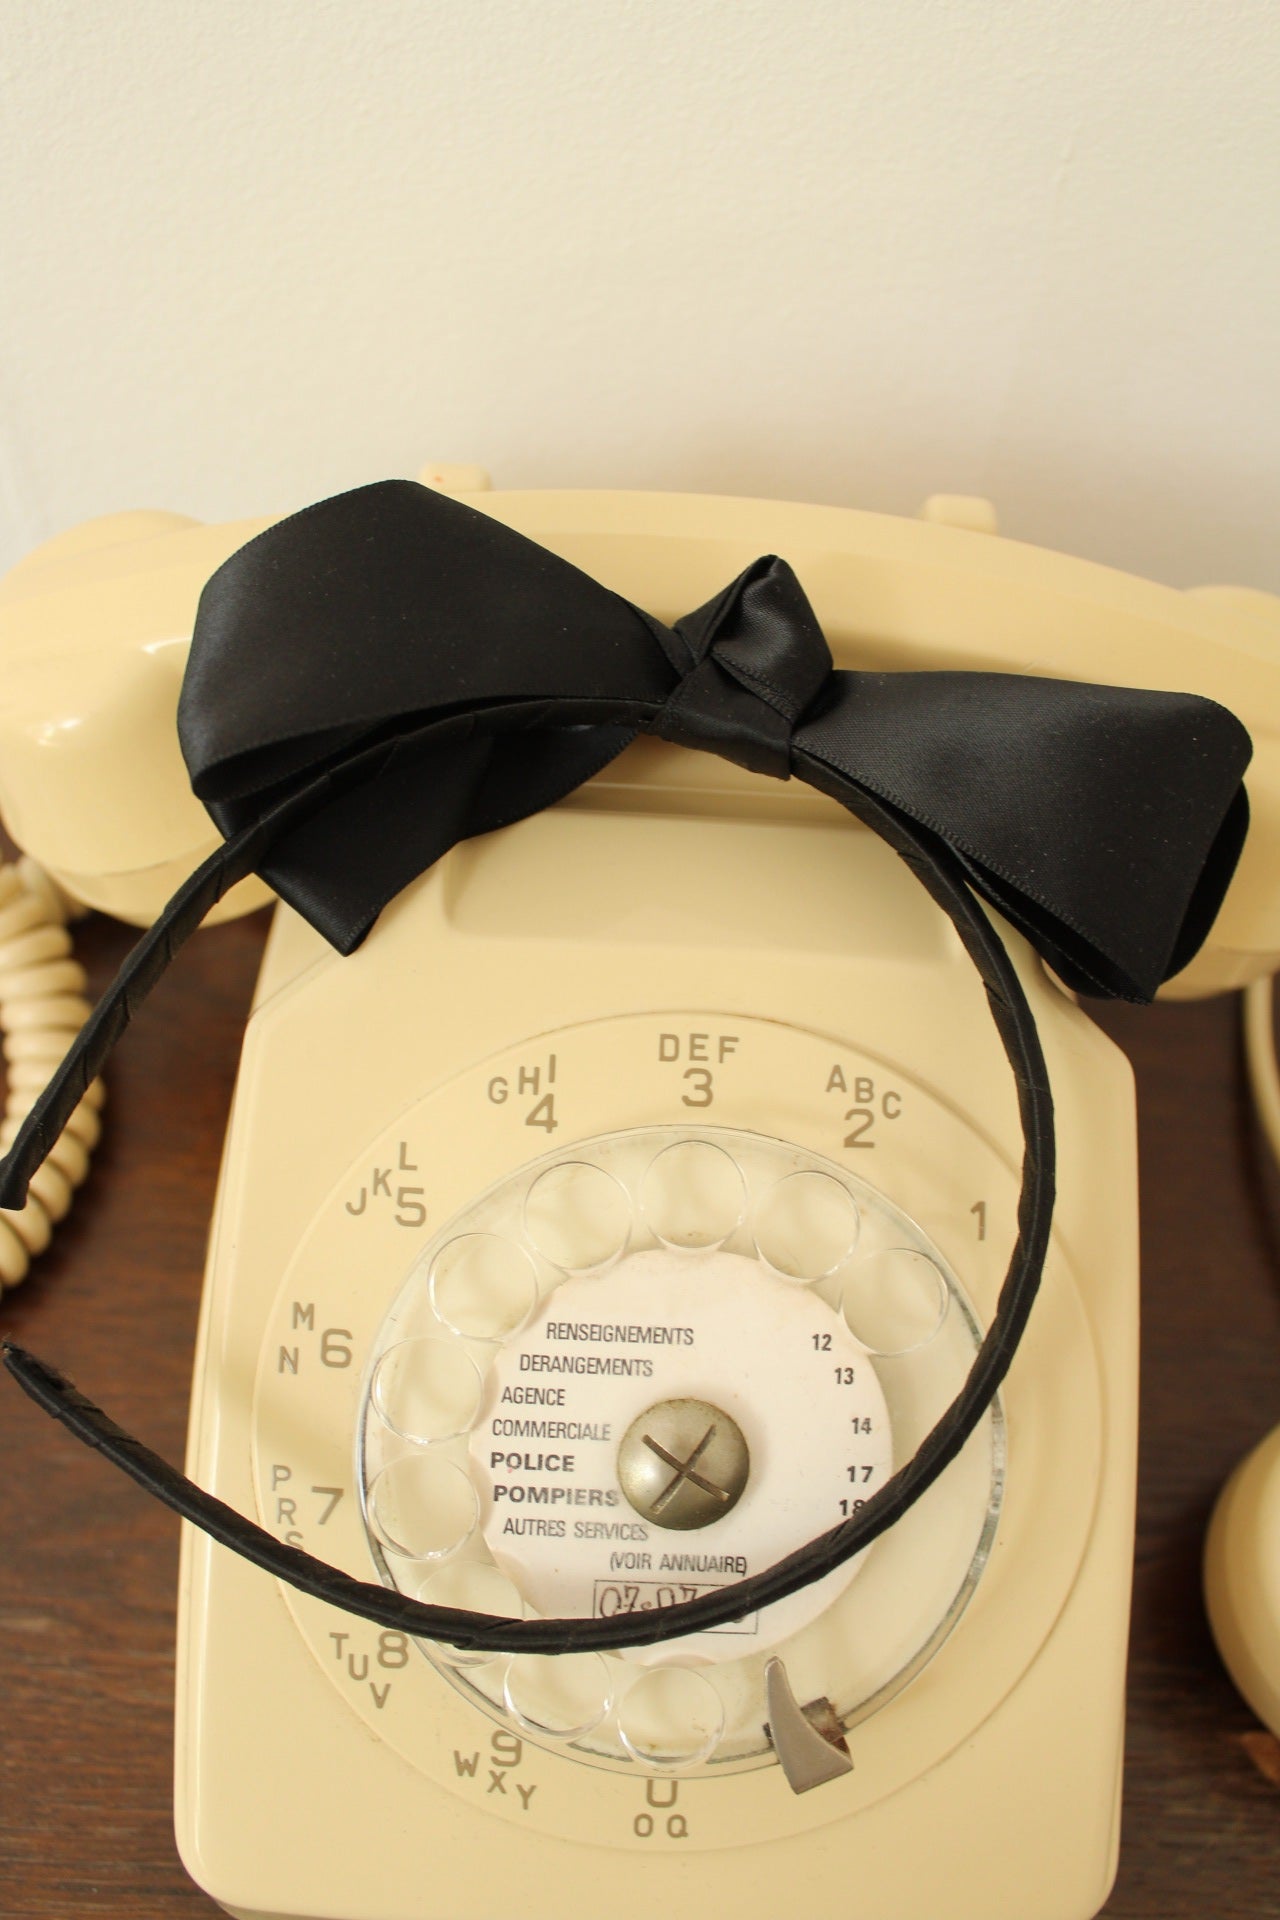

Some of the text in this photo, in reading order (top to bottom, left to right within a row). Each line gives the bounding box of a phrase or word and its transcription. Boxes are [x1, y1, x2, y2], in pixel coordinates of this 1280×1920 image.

[658, 1033, 740, 1064] DEF
[487, 1054, 557, 1105] GHI
[681, 1067, 714, 1108] 3
[825, 1064, 902, 1120] ABC
[524, 1093, 558, 1134] 4
[843, 1108, 875, 1149] 2
[345, 1141, 418, 1216] JKL
[394, 1186, 427, 1228] 5
[970, 1201, 986, 1241] 1
[320, 1328, 353, 1369] 6
[546, 1321, 833, 1351] RENSEIGNEMENTS 12
[519, 1353, 854, 1385] DERANGEMENTS 13
[500, 1386, 566, 1407] AGENCE
[492, 1417, 872, 1442] COMMERCIALE 14
[490, 1451, 874, 1483] POLICE 17
[311, 1485, 345, 1526] 7
[493, 1484, 620, 1507] POMPIERS
[503, 1517, 650, 1542] AUTRES SERVICES
[609, 1551, 748, 1577] (VOIR ANNUAIRE)
[376, 1630, 410, 1669] 8
[490, 1730, 523, 1768] 9
